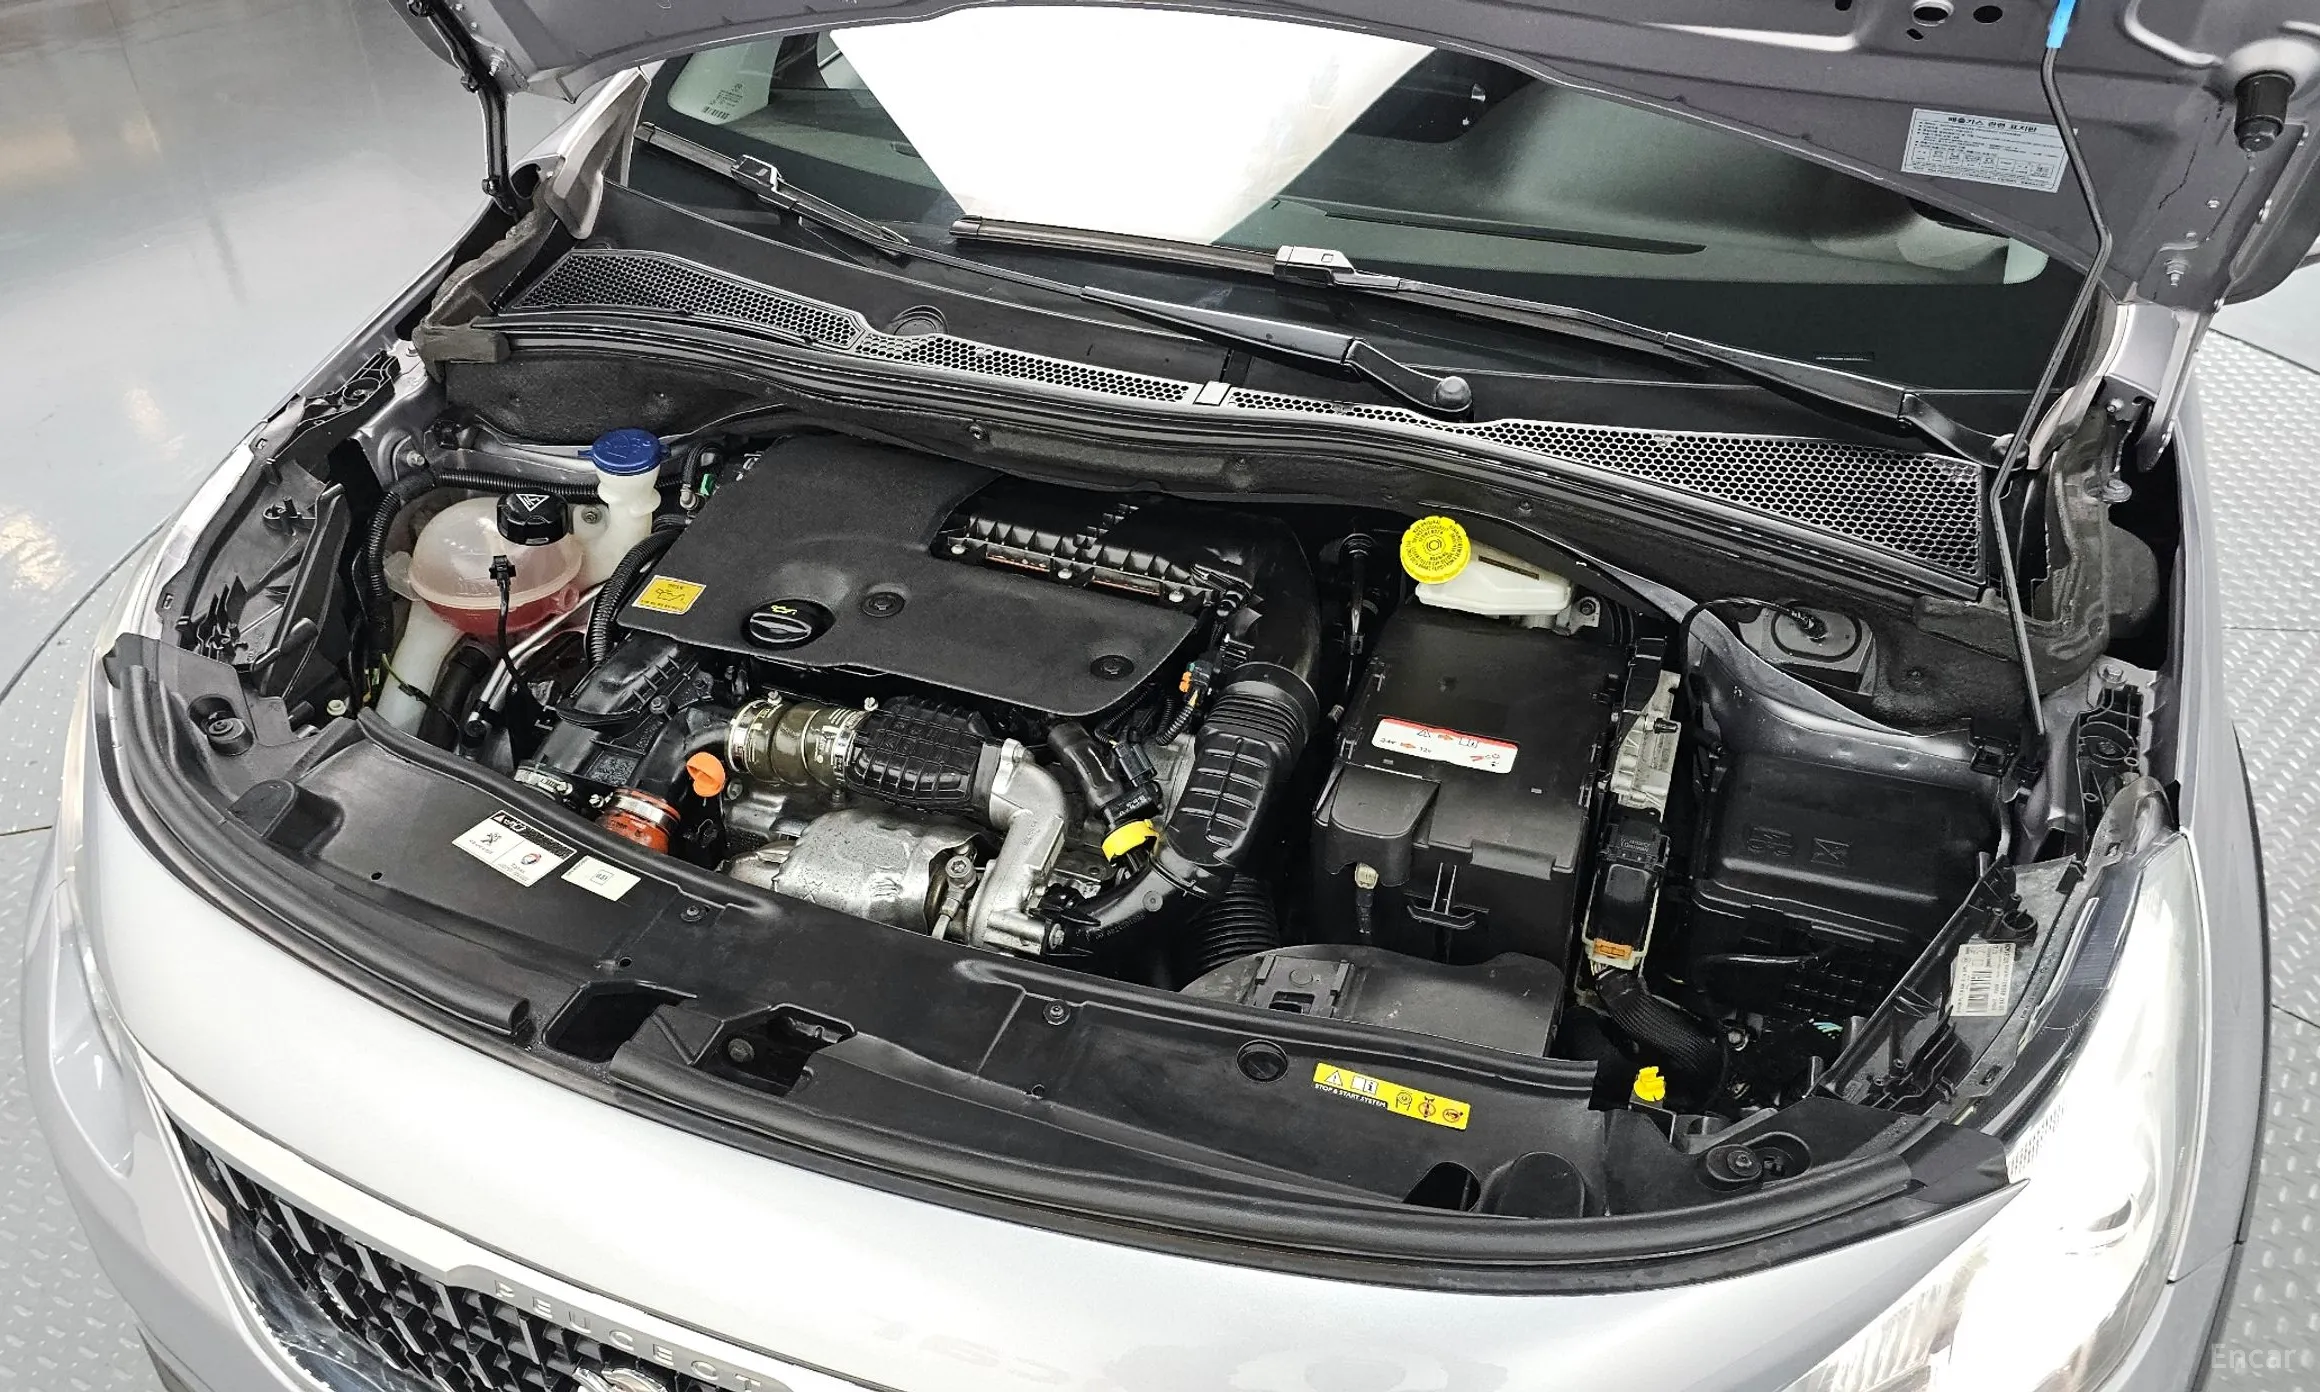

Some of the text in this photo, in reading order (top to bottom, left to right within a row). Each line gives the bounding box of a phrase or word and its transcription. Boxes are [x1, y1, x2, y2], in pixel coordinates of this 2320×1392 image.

[1314, 1083, 1332, 1093] STOP
[1339, 1089, 1359, 1102] START
[1359, 1094, 1387, 1109] SYSTEM
